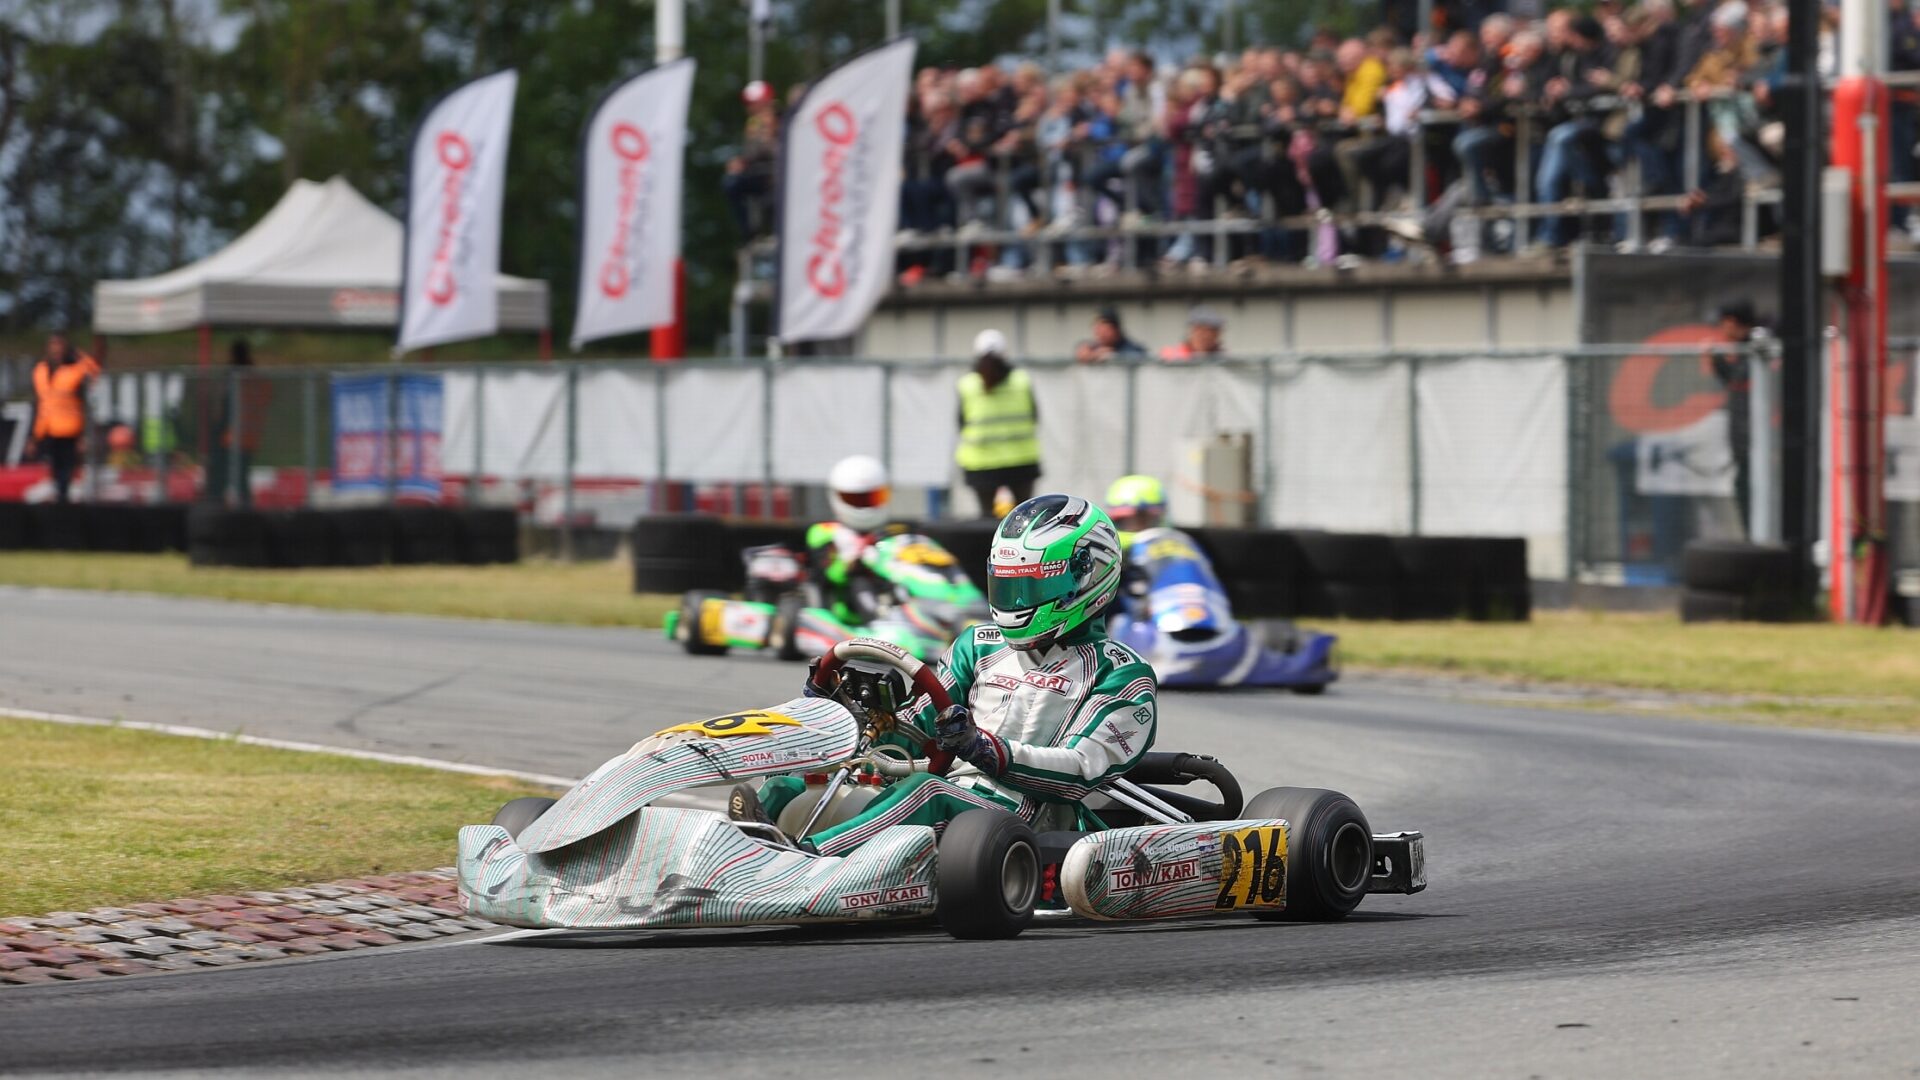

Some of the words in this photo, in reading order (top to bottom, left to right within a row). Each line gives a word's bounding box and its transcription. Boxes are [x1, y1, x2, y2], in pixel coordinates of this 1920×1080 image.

[1018, 567, 1039, 575] ITALY
[977, 630, 1001, 640] OMP
[1024, 672, 1071, 691] KART
[741, 751, 774, 763] ROTAX
[1112, 869, 1154, 889] TONY
[1160, 860, 1200, 882] KART
[1215, 828, 1286, 910] 216
[841, 892, 880, 908] TONY
[888, 886, 927, 902] KART
